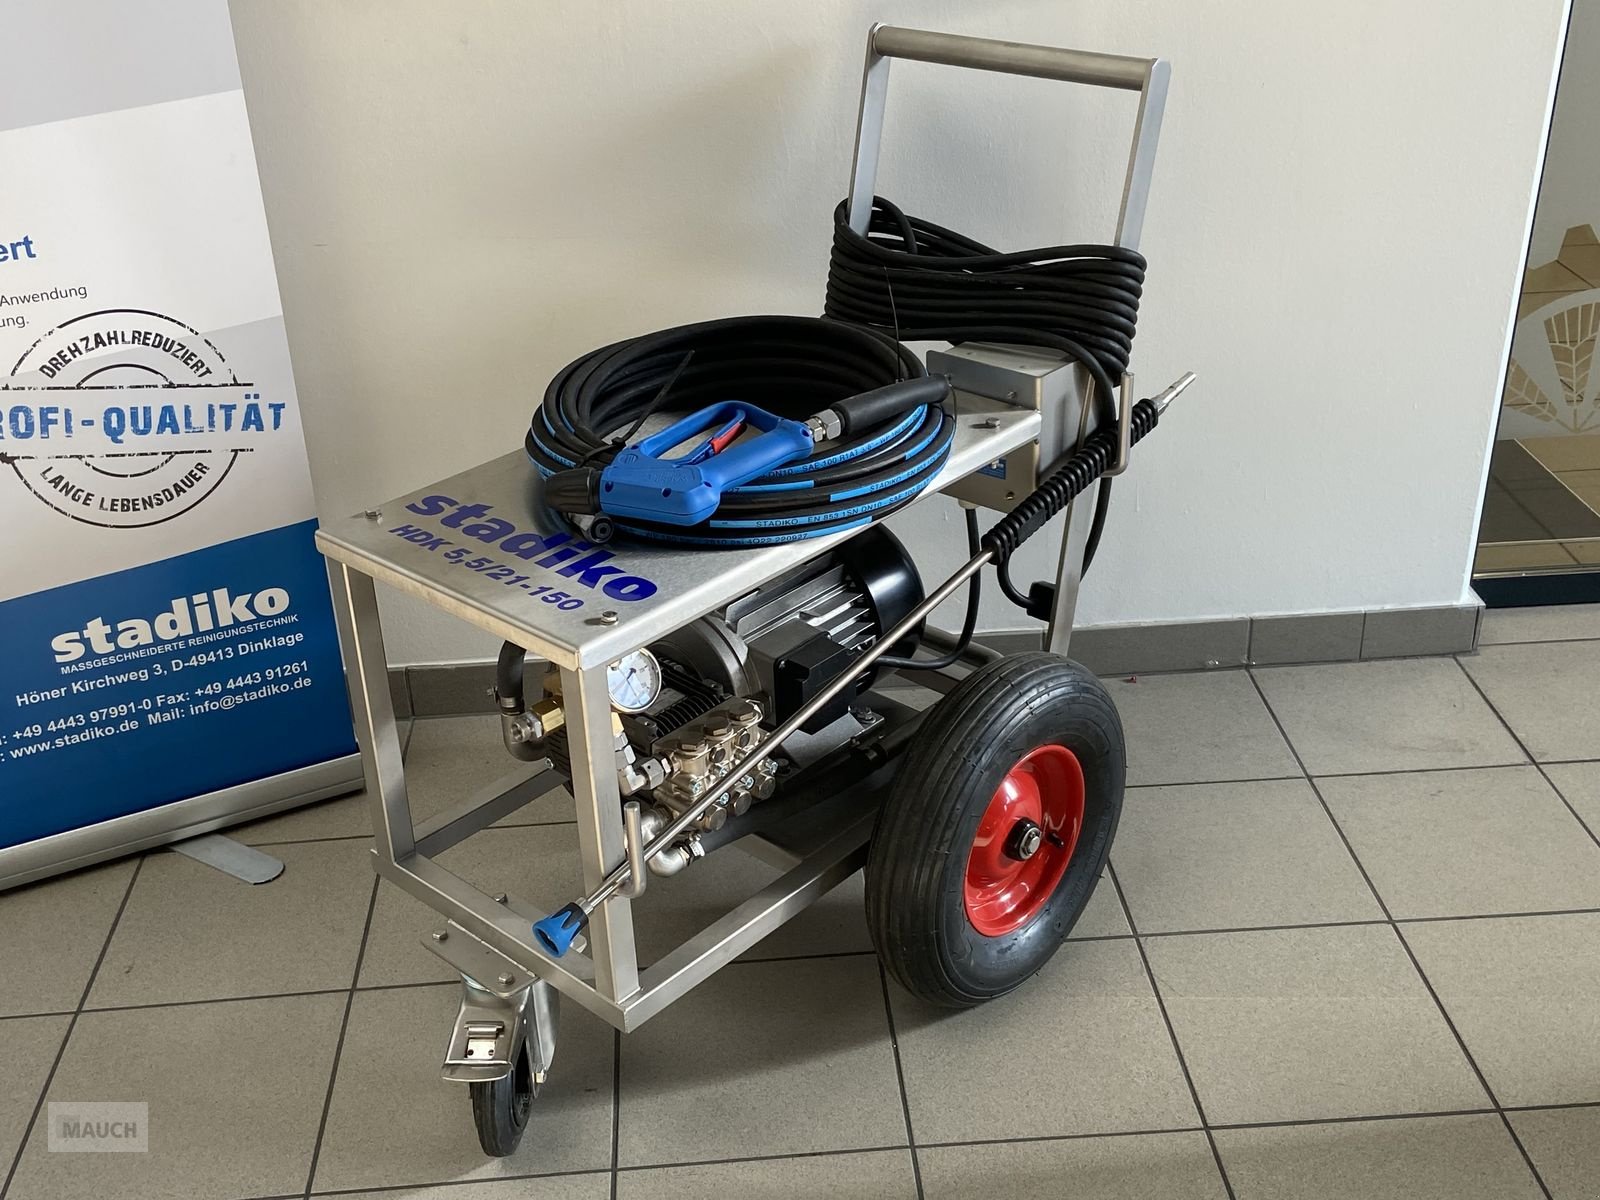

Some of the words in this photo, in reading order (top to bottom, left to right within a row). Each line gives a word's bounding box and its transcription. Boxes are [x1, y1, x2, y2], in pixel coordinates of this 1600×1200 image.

[0, 286, 88, 307] Anwendung
[39, 329, 213, 379] DREHZAHLREDUZIERT
[0, 393, 286, 444] OFI-QUALITÄT
[40, 466, 95, 507] LANGE
[99, 462, 210, 513] LEBENSDAUER
[870, 476, 902, 490] STADIKO
[756, 518, 799, 527] STADIKO
[842, 508, 859, 517] 1SN
[861, 502, 882, 513] DN10
[389, 524, 453, 551] HDK
[443, 548, 585, 611] 5,5/21-150
[405, 495, 658, 601] stadiko
[51, 587, 290, 664] stadiko
[60, 641, 186, 675] MASSGESCHNEIDERTE
[188, 614, 299, 647] REINIGUNGSTECHNIK
[12, 724, 43, 739] +49
[47, 714, 86, 732] 4443
[89, 698, 152, 723] 97991-0
[156, 691, 190, 708] Fax:
[194, 682, 222, 697] +49
[226, 672, 262, 690] 4443
[266, 660, 308, 680] 91261
[15, 686, 67, 707] Höner
[71, 668, 149, 694] Kirchweg
[153, 664, 168, 676] 3,
[172, 647, 235, 672] D-49413
[238, 632, 304, 656] Dinklage
[10, 720, 139, 759] www.stadiko.de
[148, 707, 185, 726] Mail:
[190, 676, 312, 715] info@stadiko.de
